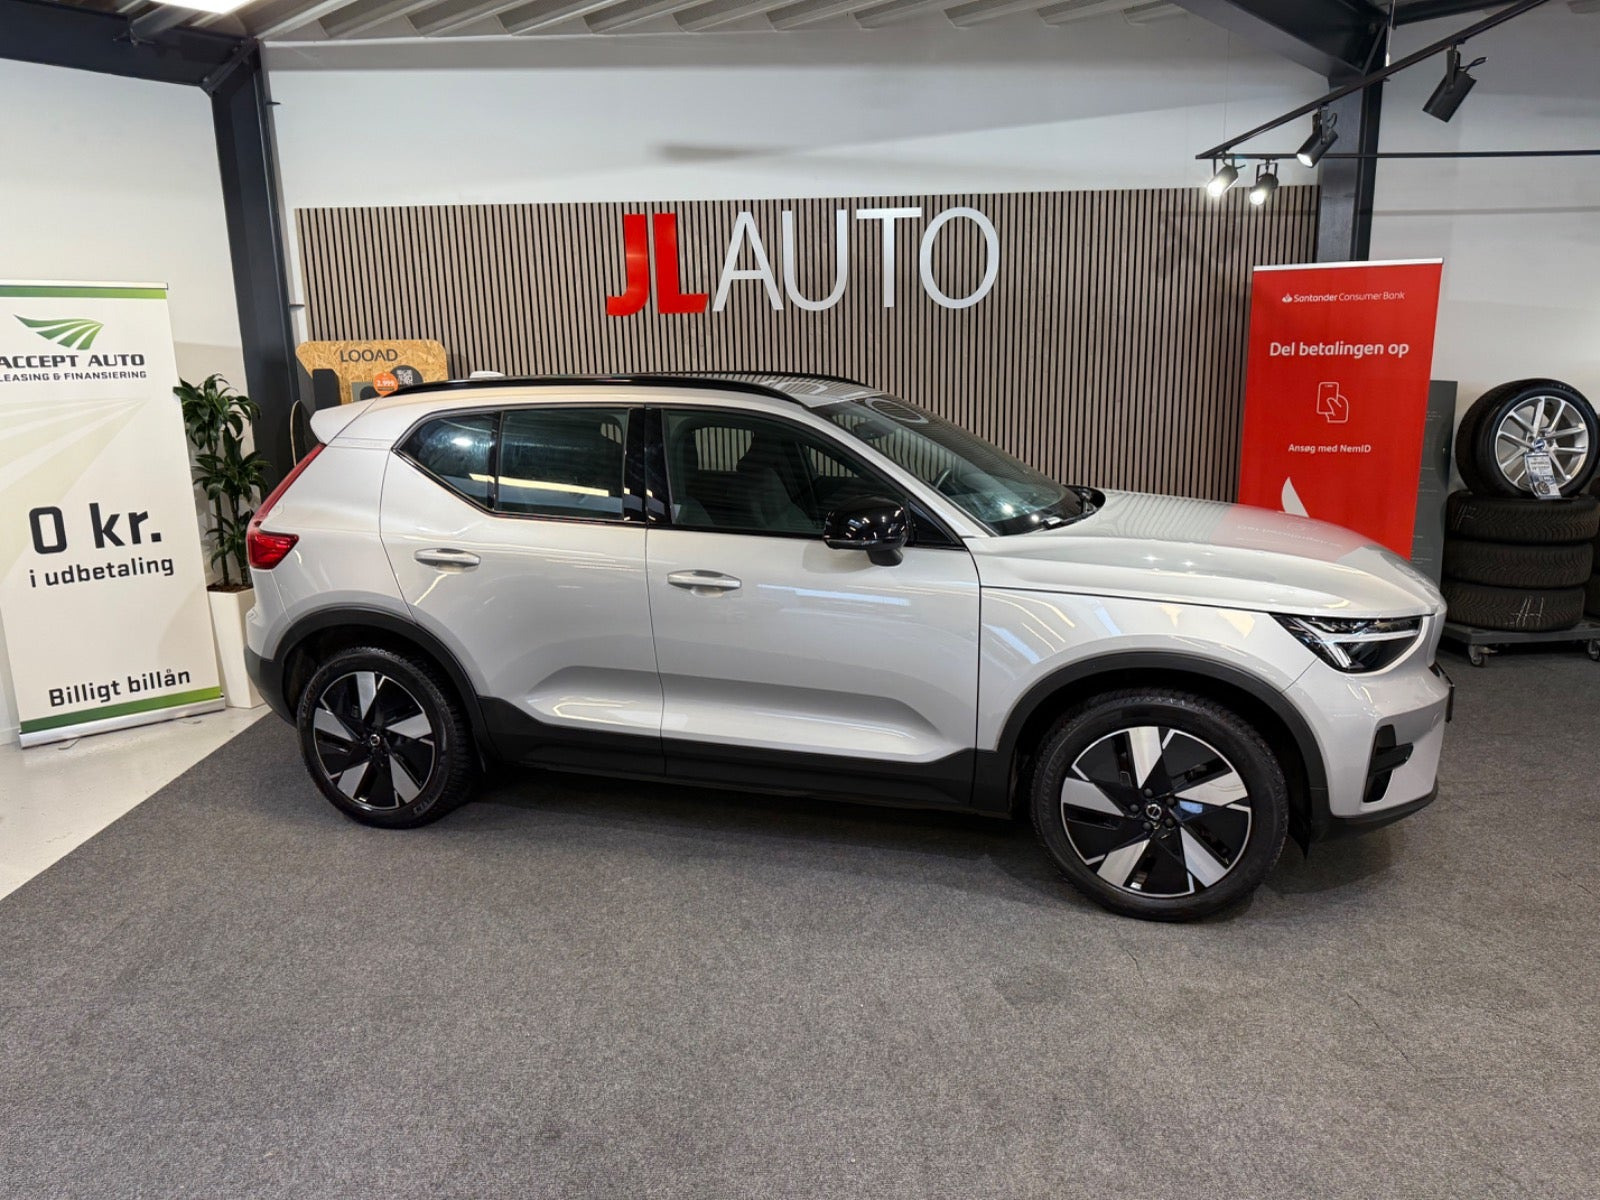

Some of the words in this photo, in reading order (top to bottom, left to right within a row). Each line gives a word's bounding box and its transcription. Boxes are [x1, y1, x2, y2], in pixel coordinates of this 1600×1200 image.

[1294, 293, 1337, 303] Santander
[1338, 291, 1383, 301] Consumer
[1383, 290, 1405, 300] Bank
[339, 349, 398, 362] LOOAD
[1269, 342, 1295, 356] Del
[1299, 341, 1383, 359] betalingen
[1388, 343, 1409, 358] op
[0, 355, 79, 368] ACCEPT
[88, 354, 145, 367] AUTO
[53, 373, 61, 381] &
[64, 371, 147, 380] FINANSIERING
[1288, 443, 1316, 454] Ansøg
[1318, 444, 1338, 453] med
[1340, 444, 1372, 453] NemID
[29, 506, 67, 555] 0
[89, 502, 162, 549] kr.
[29, 569, 37, 588] i
[45, 557, 174, 586] udbetaling
[49, 681, 121, 707] Billigt
[127, 668, 191, 693] billån
